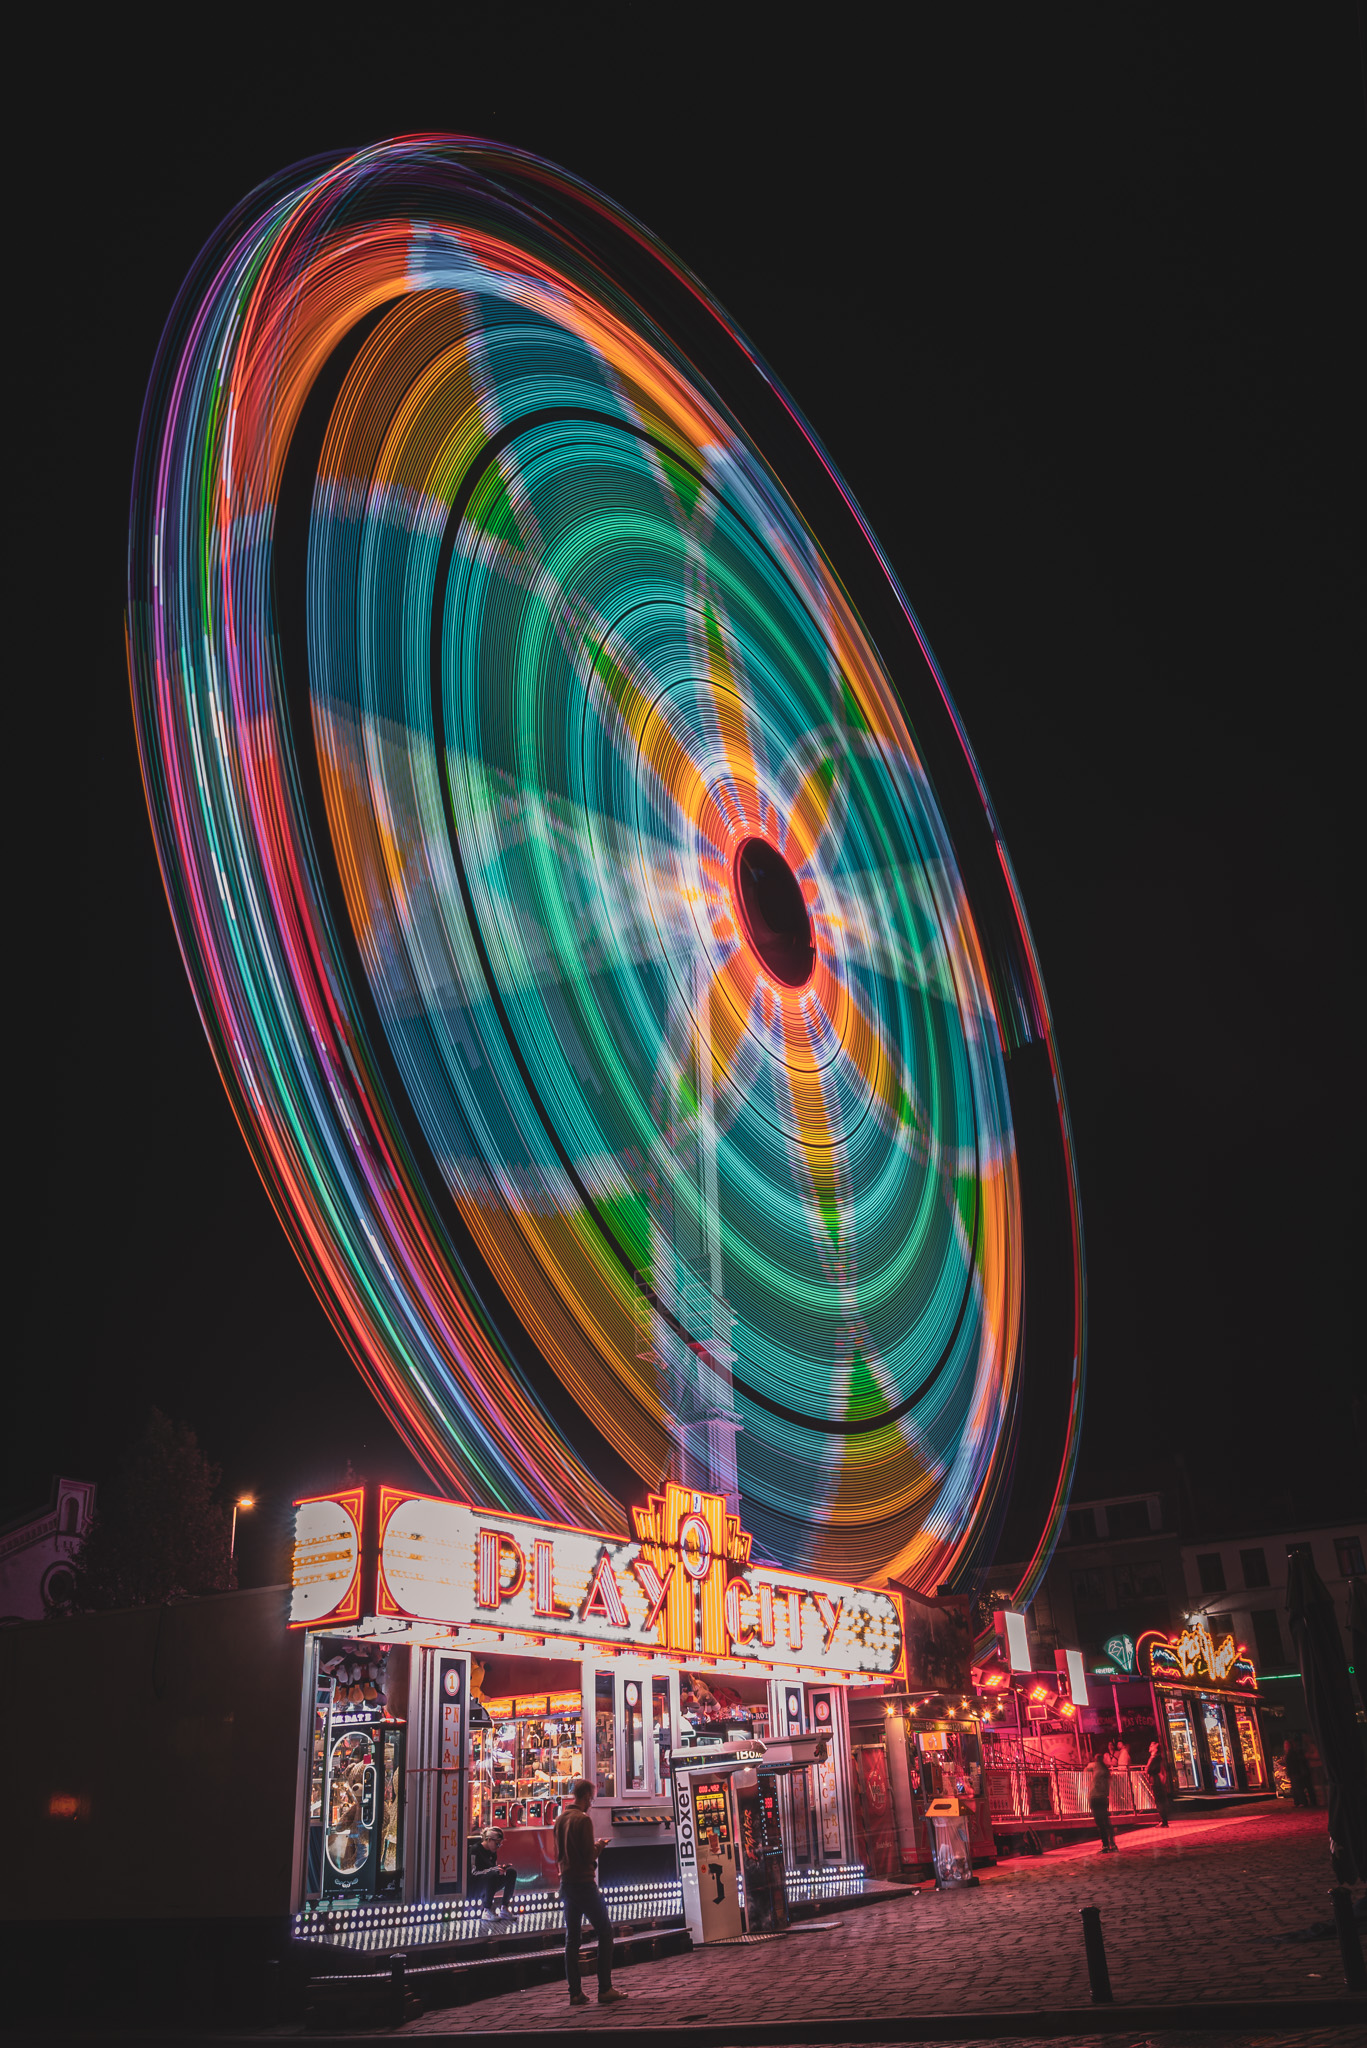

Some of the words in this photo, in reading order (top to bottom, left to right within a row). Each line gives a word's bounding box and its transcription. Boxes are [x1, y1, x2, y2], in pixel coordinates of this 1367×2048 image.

[477, 1526, 674, 1632] PLAY
[725, 1576, 845, 1655] CITY
[449, 1675, 455, 1690] 1
[791, 1699, 796, 1711] 1
[819, 1705, 825, 1717] 1
[679, 1782, 695, 1867] iBoxer
